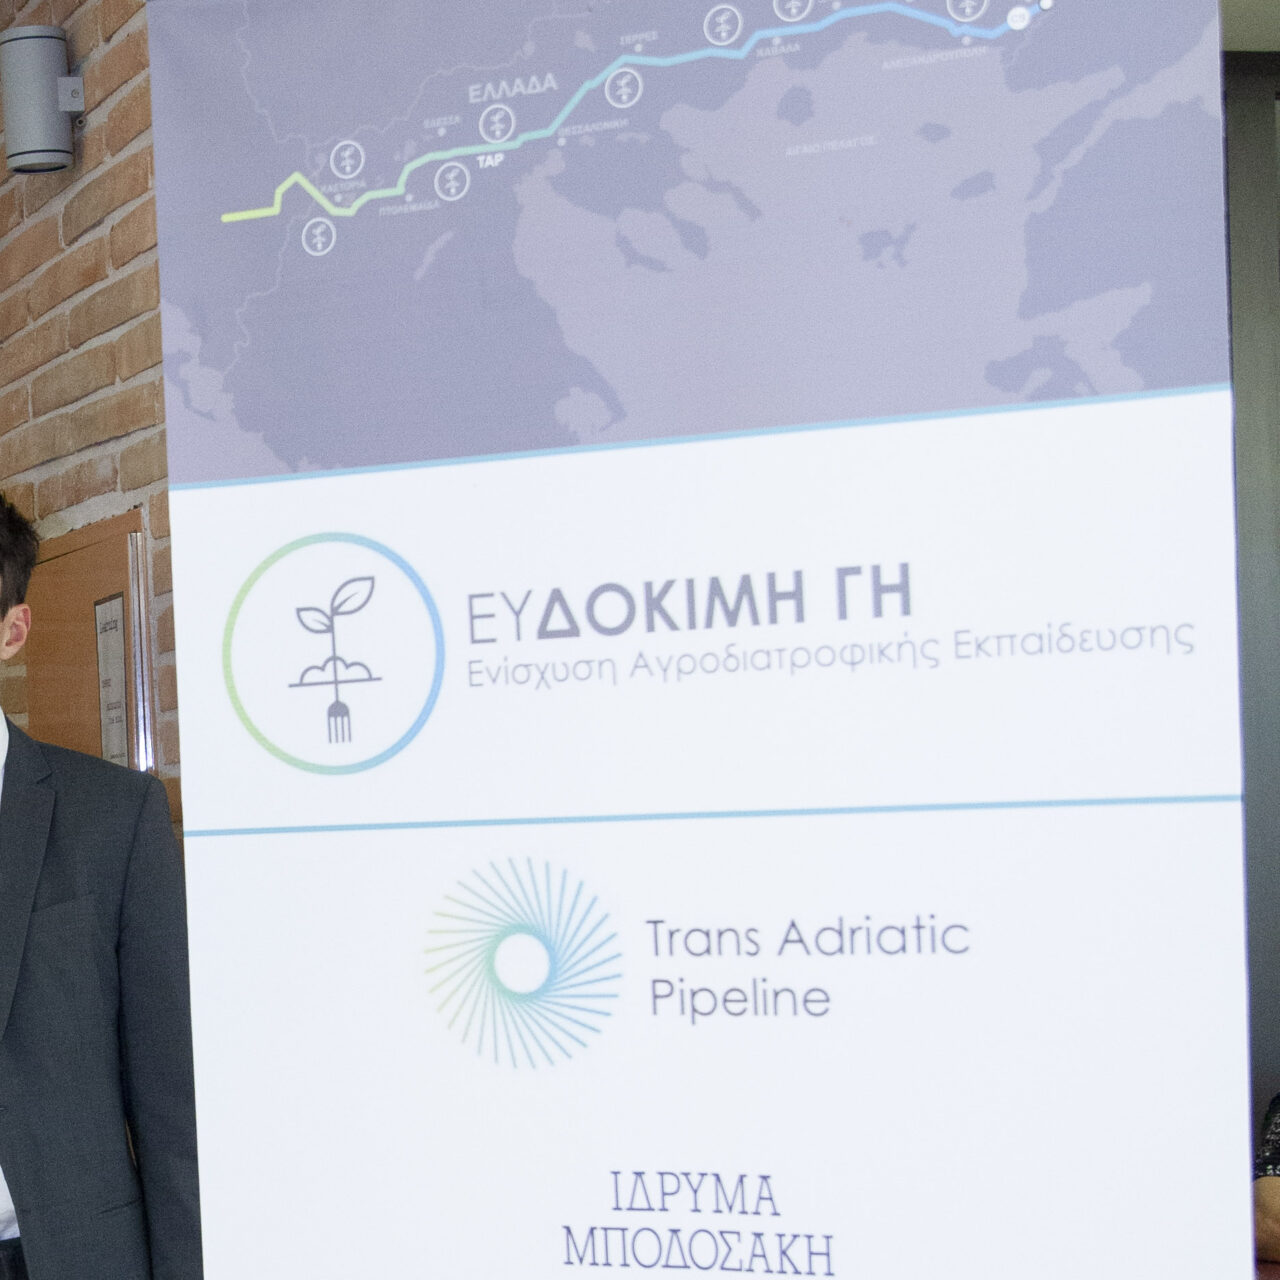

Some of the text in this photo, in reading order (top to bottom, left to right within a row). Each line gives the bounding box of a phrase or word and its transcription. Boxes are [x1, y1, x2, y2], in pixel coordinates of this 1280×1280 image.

[468, 72, 559, 104] ΕΛΛΑΔΑ
[477, 152, 505, 169] TAP
[467, 562, 913, 645] ΕΥΔΟΚΙΜΗ ΓΗ
[467, 616, 1194, 690] Ενίσχυση Αγροδιατροφικής Εκπαίδευσης
[646, 915, 970, 957] Trans Adriatic
[651, 978, 831, 1025] Pipeline
[609, 1171, 781, 1216] ΙΔΡΥΜΑ
[562, 1226, 835, 1277] ΜΠΟΔΟΣΑΚΗ
